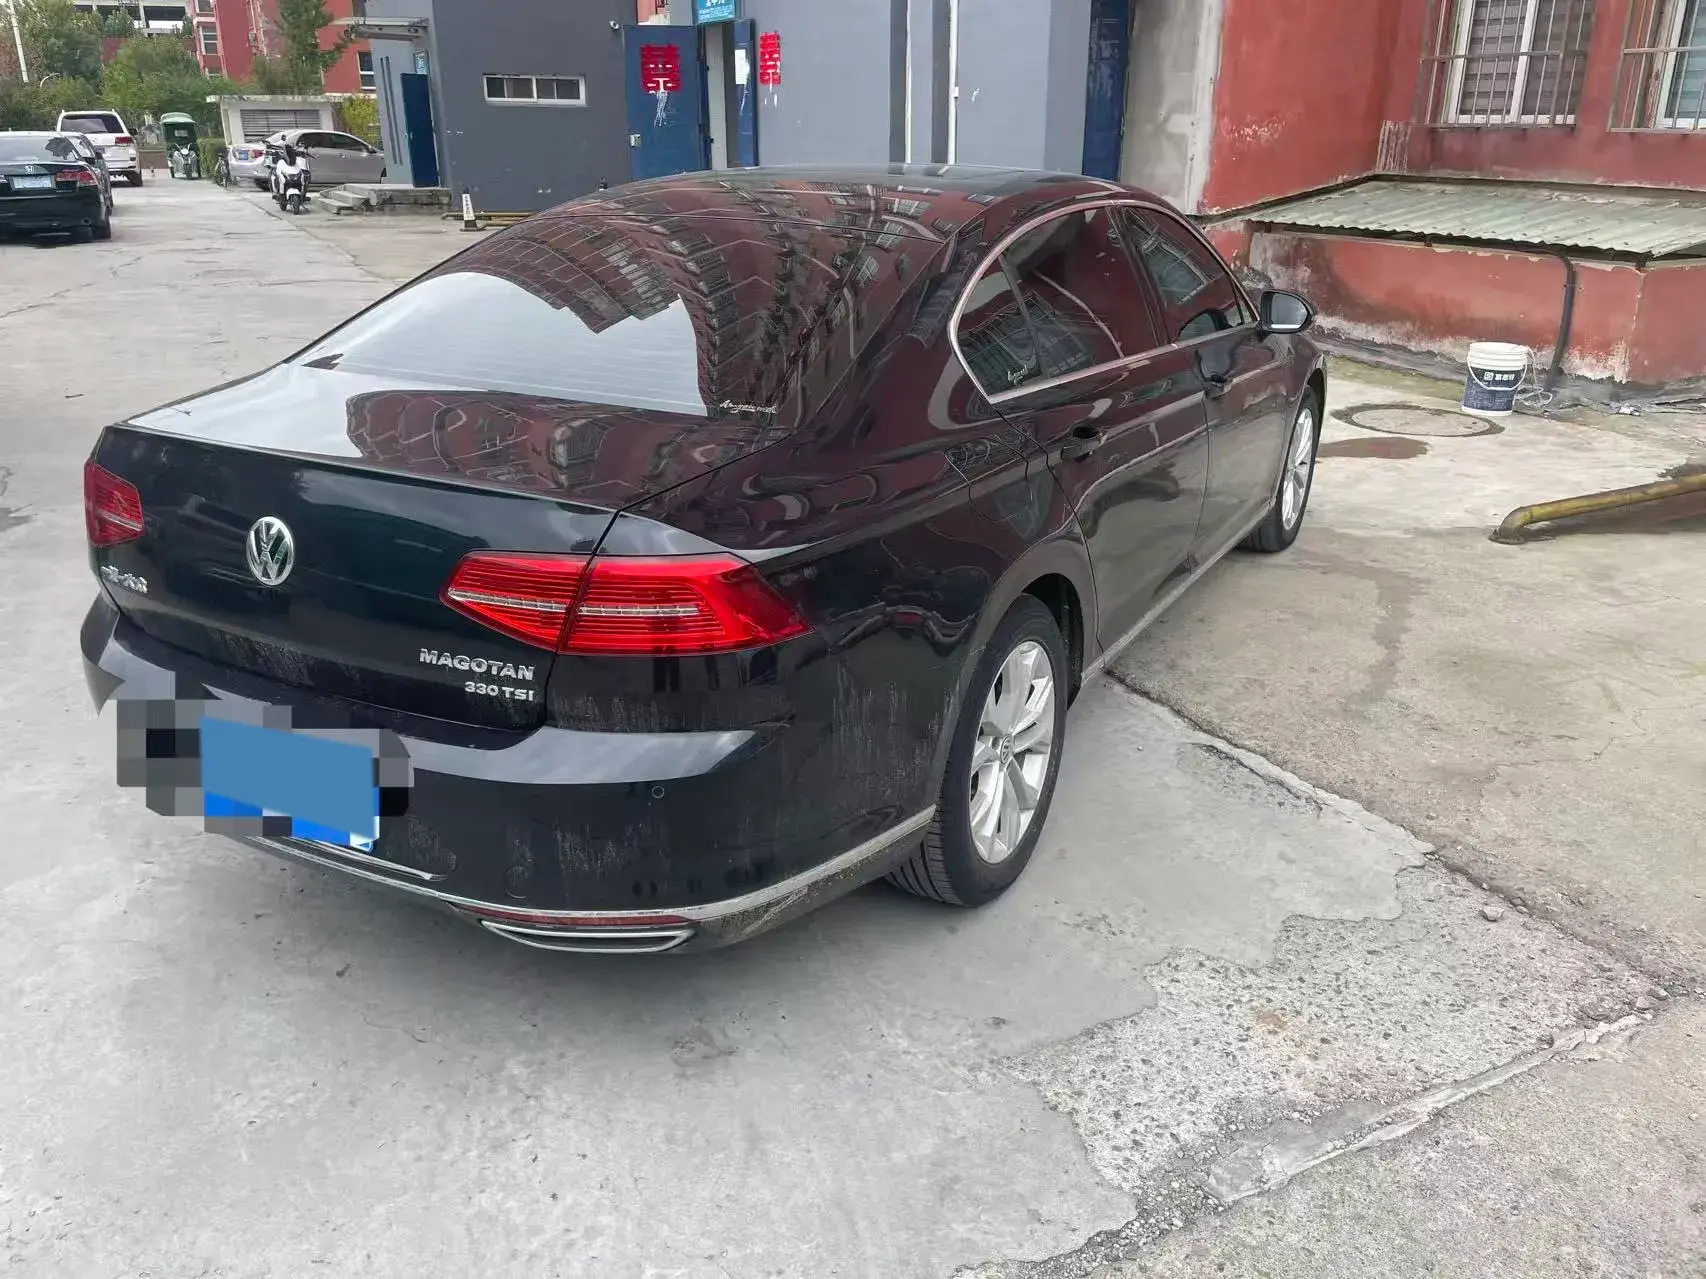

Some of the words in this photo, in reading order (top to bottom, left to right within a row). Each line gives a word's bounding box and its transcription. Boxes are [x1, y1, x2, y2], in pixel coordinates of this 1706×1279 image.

[419, 648, 534, 681] MAGOTAN
[464, 681, 499, 697] 330
[502, 686, 534, 702] TSI
